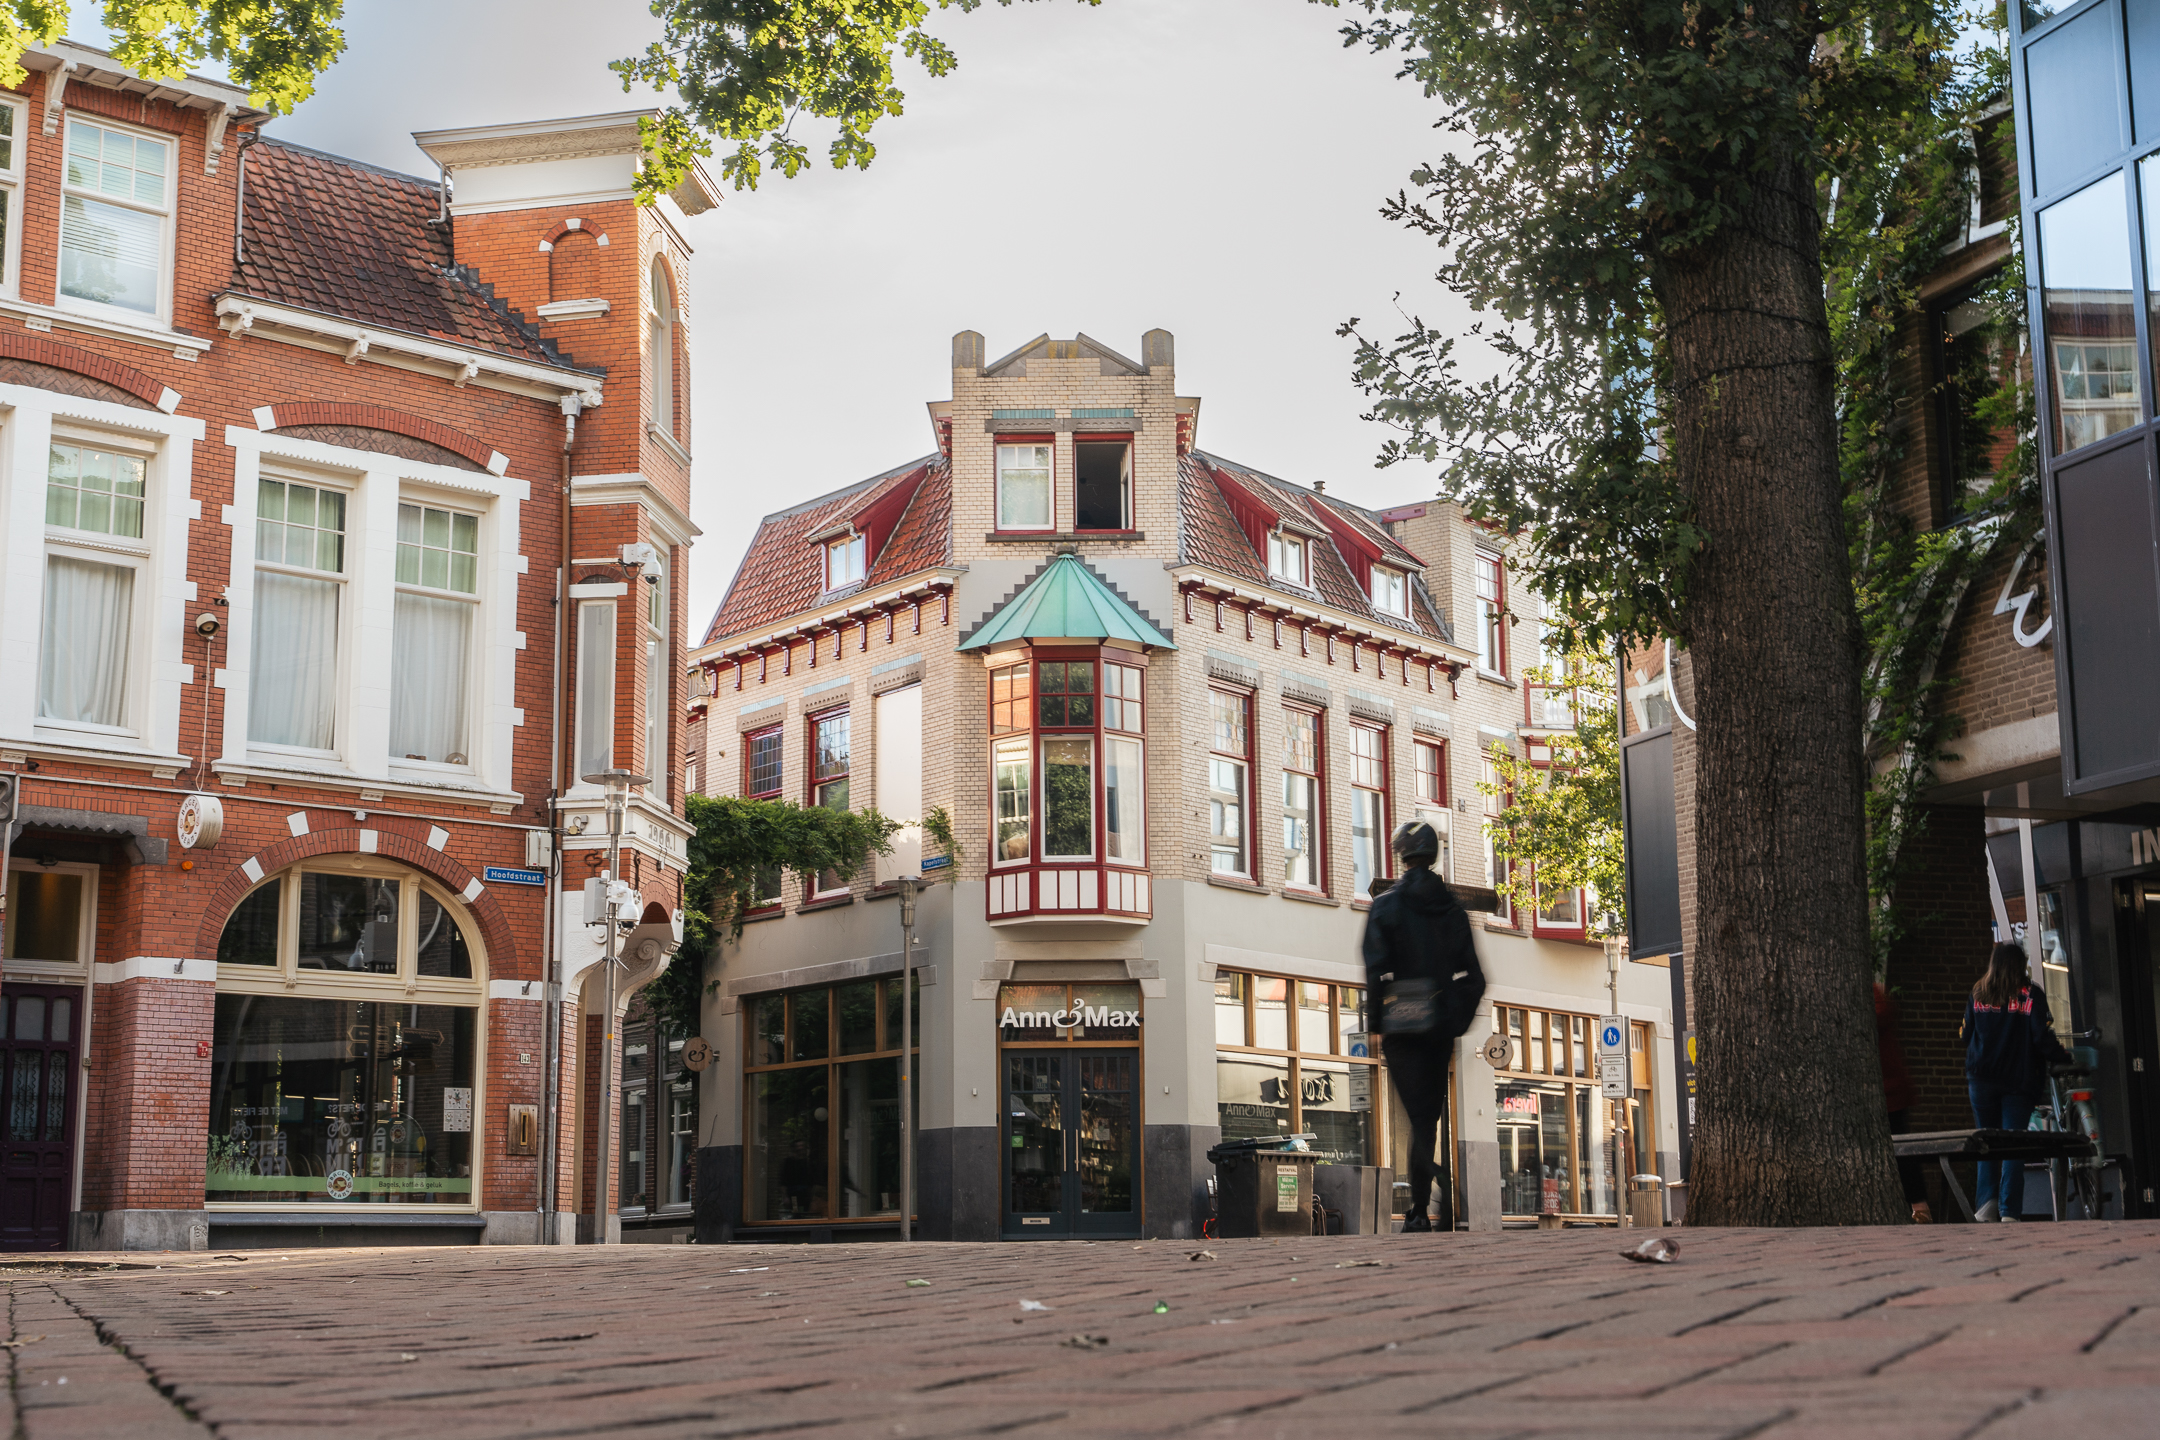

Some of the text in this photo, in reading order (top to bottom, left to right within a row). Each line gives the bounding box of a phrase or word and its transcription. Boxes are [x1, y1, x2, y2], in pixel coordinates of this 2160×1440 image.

[181, 799, 199, 815] BAGELS
[491, 870, 541, 882] Hoofdstraat
[329, 1171, 351, 1181] BAGELS
[378, 1181, 401, 1189] Bagels,
[426, 1181, 442, 1189] geluk
